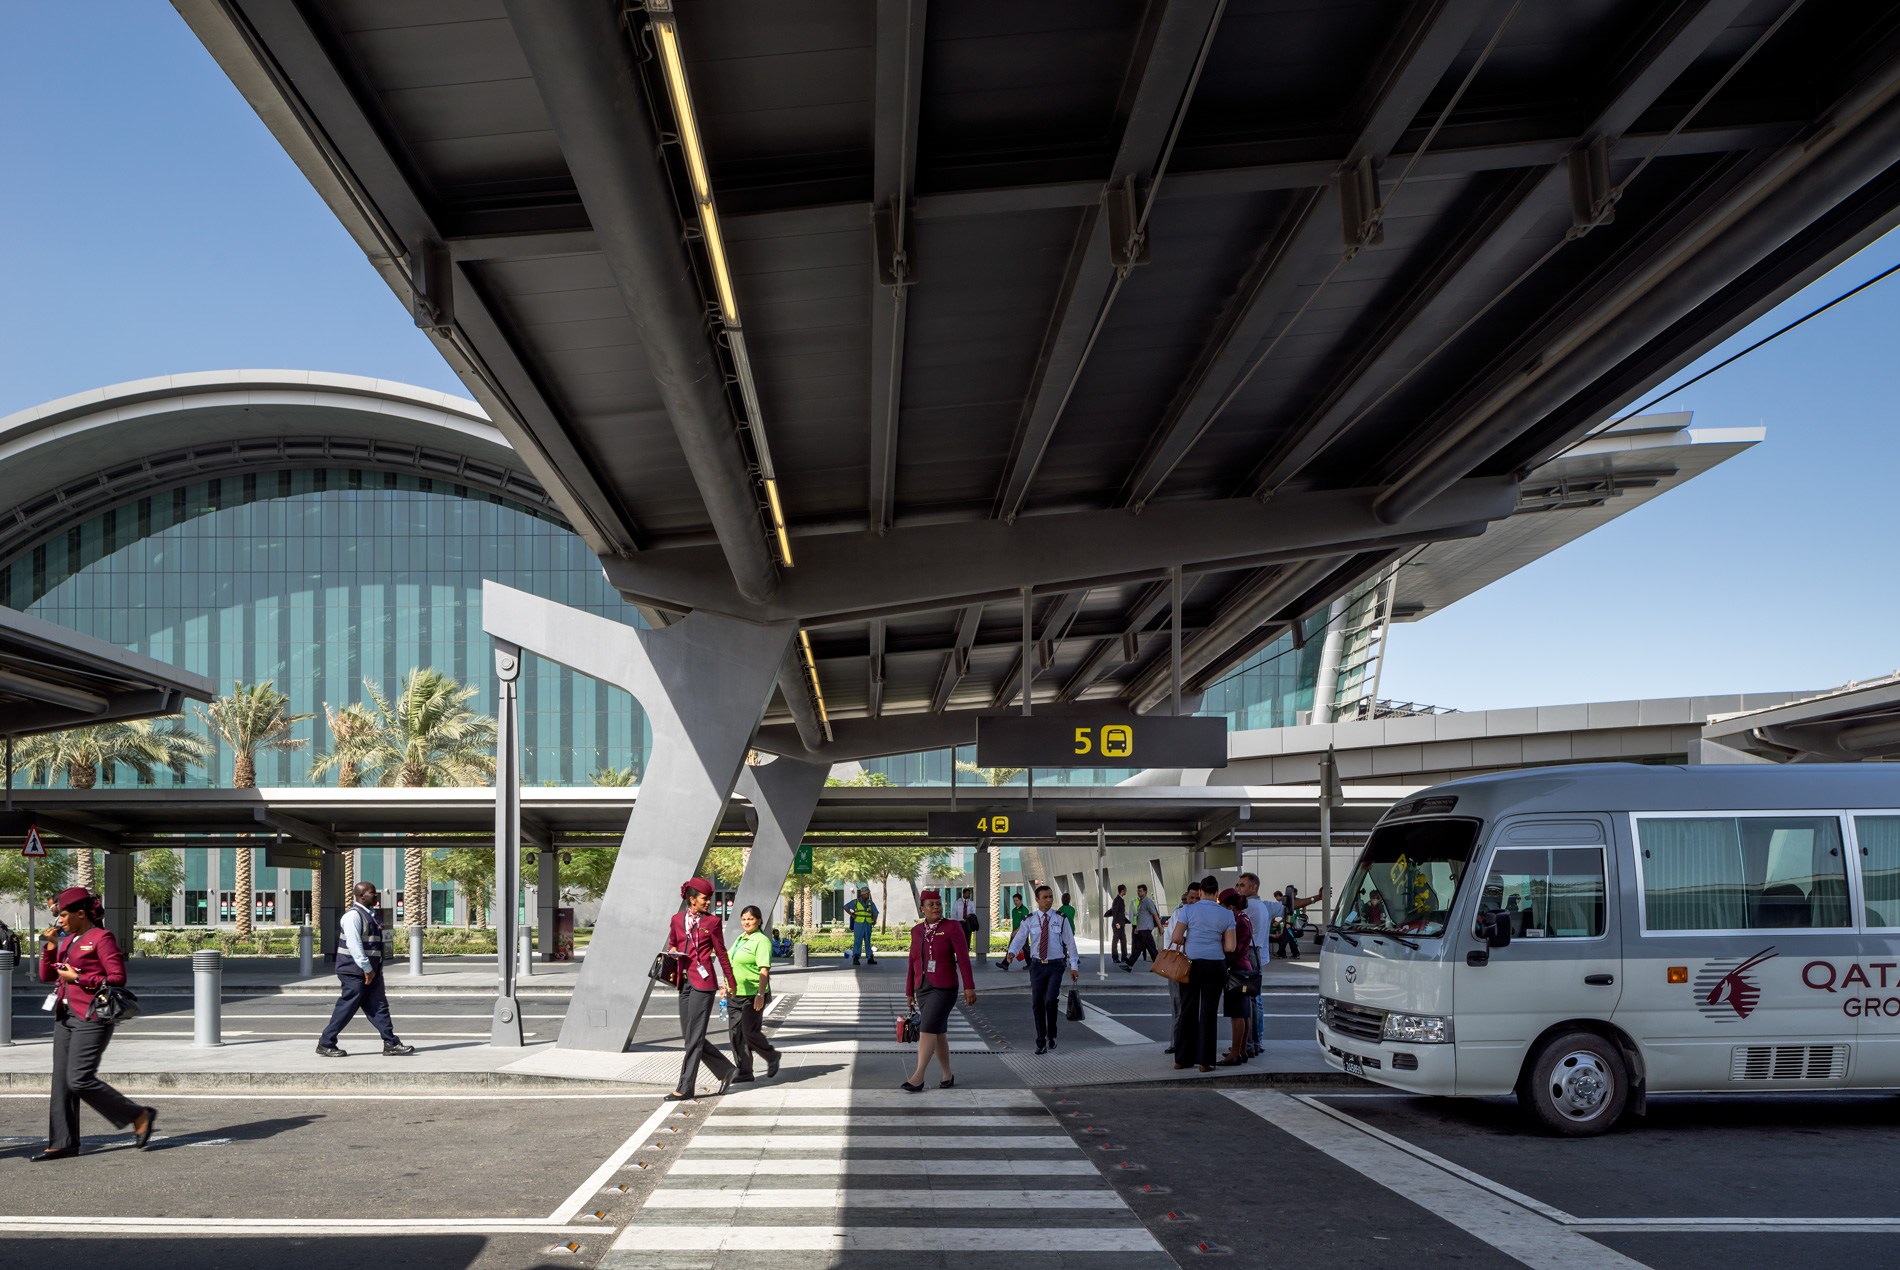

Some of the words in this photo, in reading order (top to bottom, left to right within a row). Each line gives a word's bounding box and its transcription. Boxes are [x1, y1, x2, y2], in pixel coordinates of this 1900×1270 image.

[1074, 727, 1093, 755] 5
[976, 817, 988, 832] 4
[1801, 960, 1900, 993] QAT
